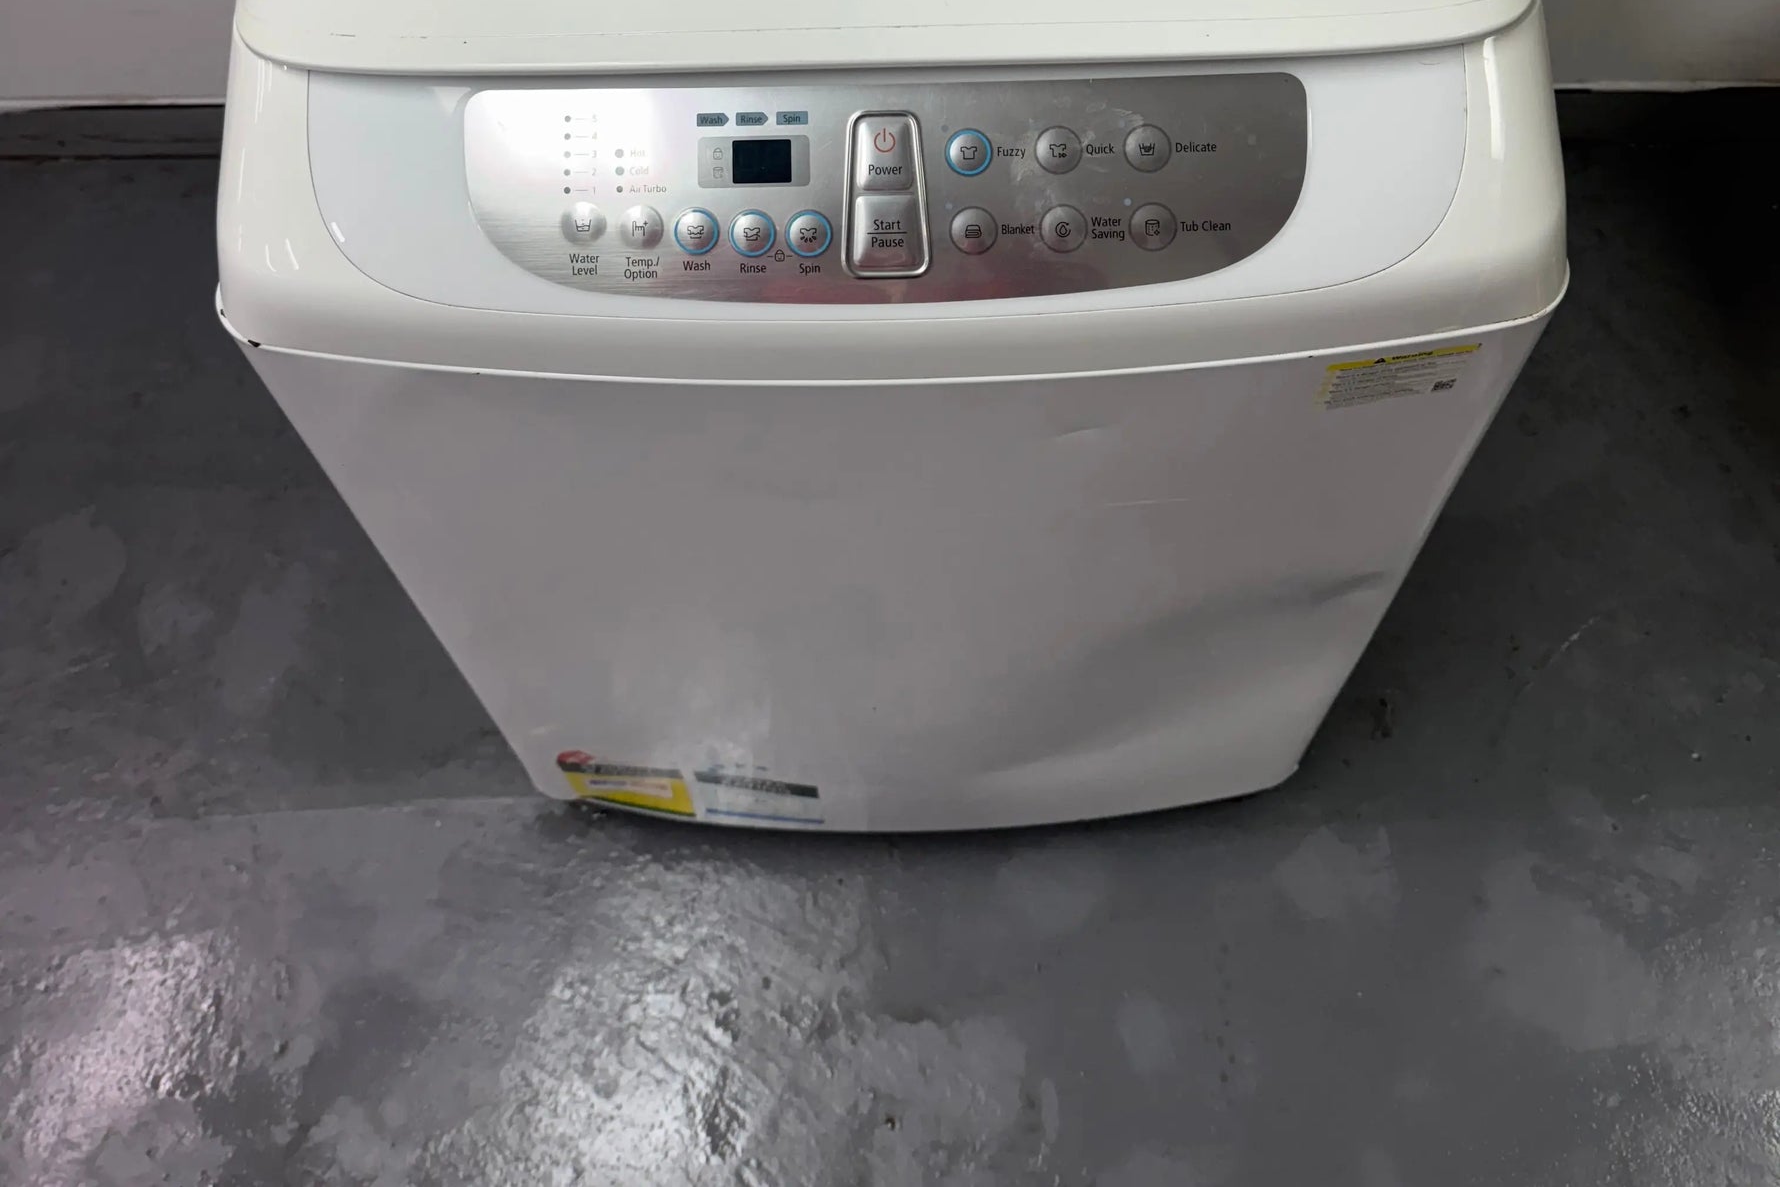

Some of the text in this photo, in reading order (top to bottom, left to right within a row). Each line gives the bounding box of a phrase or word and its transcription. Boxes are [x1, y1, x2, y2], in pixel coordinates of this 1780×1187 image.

[700, 116, 723, 125] Wash
[740, 115, 763, 124] Rinse
[783, 114, 801, 125] Spin
[997, 147, 1026, 159] Fuzzy
[1086, 143, 1115, 155] Quick
[1175, 142, 1217, 153] Delicate
[629, 166, 650, 175] Cold
[868, 164, 903, 175] Power
[643, 184, 667, 194] Turbo
[873, 219, 901, 230] Start
[1091, 217, 1121, 227] Water
[1180, 220, 1231, 232] Tub Clean
[1001, 224, 1036, 235] Blanket
[1092, 229, 1125, 241] Saving
[871, 237, 904, 248] Pause
[569, 254, 600, 264] Water
[572, 265, 598, 276] Level
[682, 260, 711, 271] Wash
[740, 262, 767, 273] Rinse
[799, 262, 821, 276] Spin
[624, 269, 658, 281] Option
